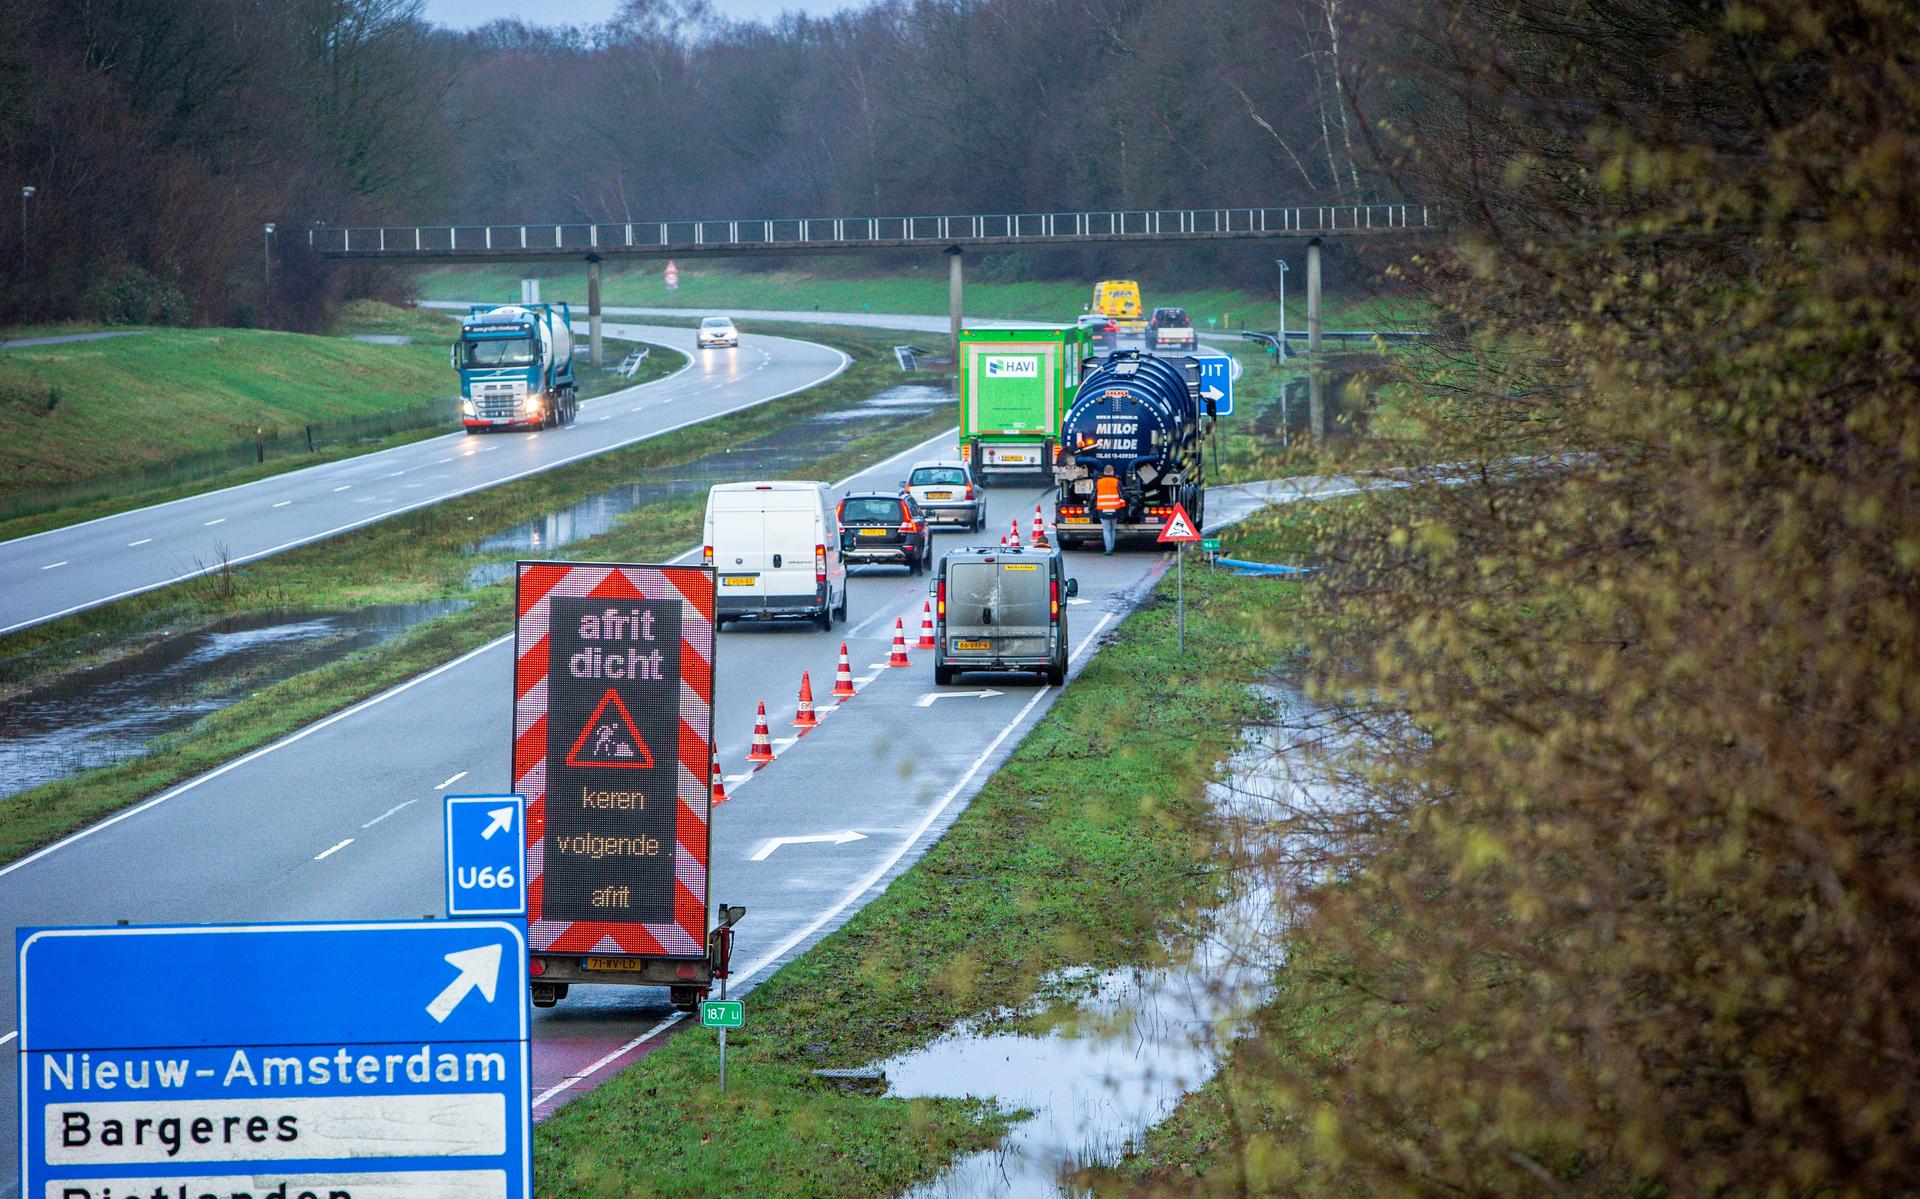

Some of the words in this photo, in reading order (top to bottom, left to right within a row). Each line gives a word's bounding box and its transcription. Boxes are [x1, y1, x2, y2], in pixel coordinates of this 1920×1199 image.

[1006, 361, 1034, 372] HAVI
[579, 608, 656, 640] afrit
[568, 647, 664, 680] dicht
[582, 786, 645, 810] keren
[556, 832, 659, 859] volgende
[457, 865, 515, 889] U66
[592, 885, 630, 909] afrit
[592, 958, 636, 969] 71-WV-LD
[707, 1007, 726, 1020] 18.7
[43, 1044, 506, 1091] Nieuw-Amsterdam
[62, 1111, 300, 1156] Bargeres
